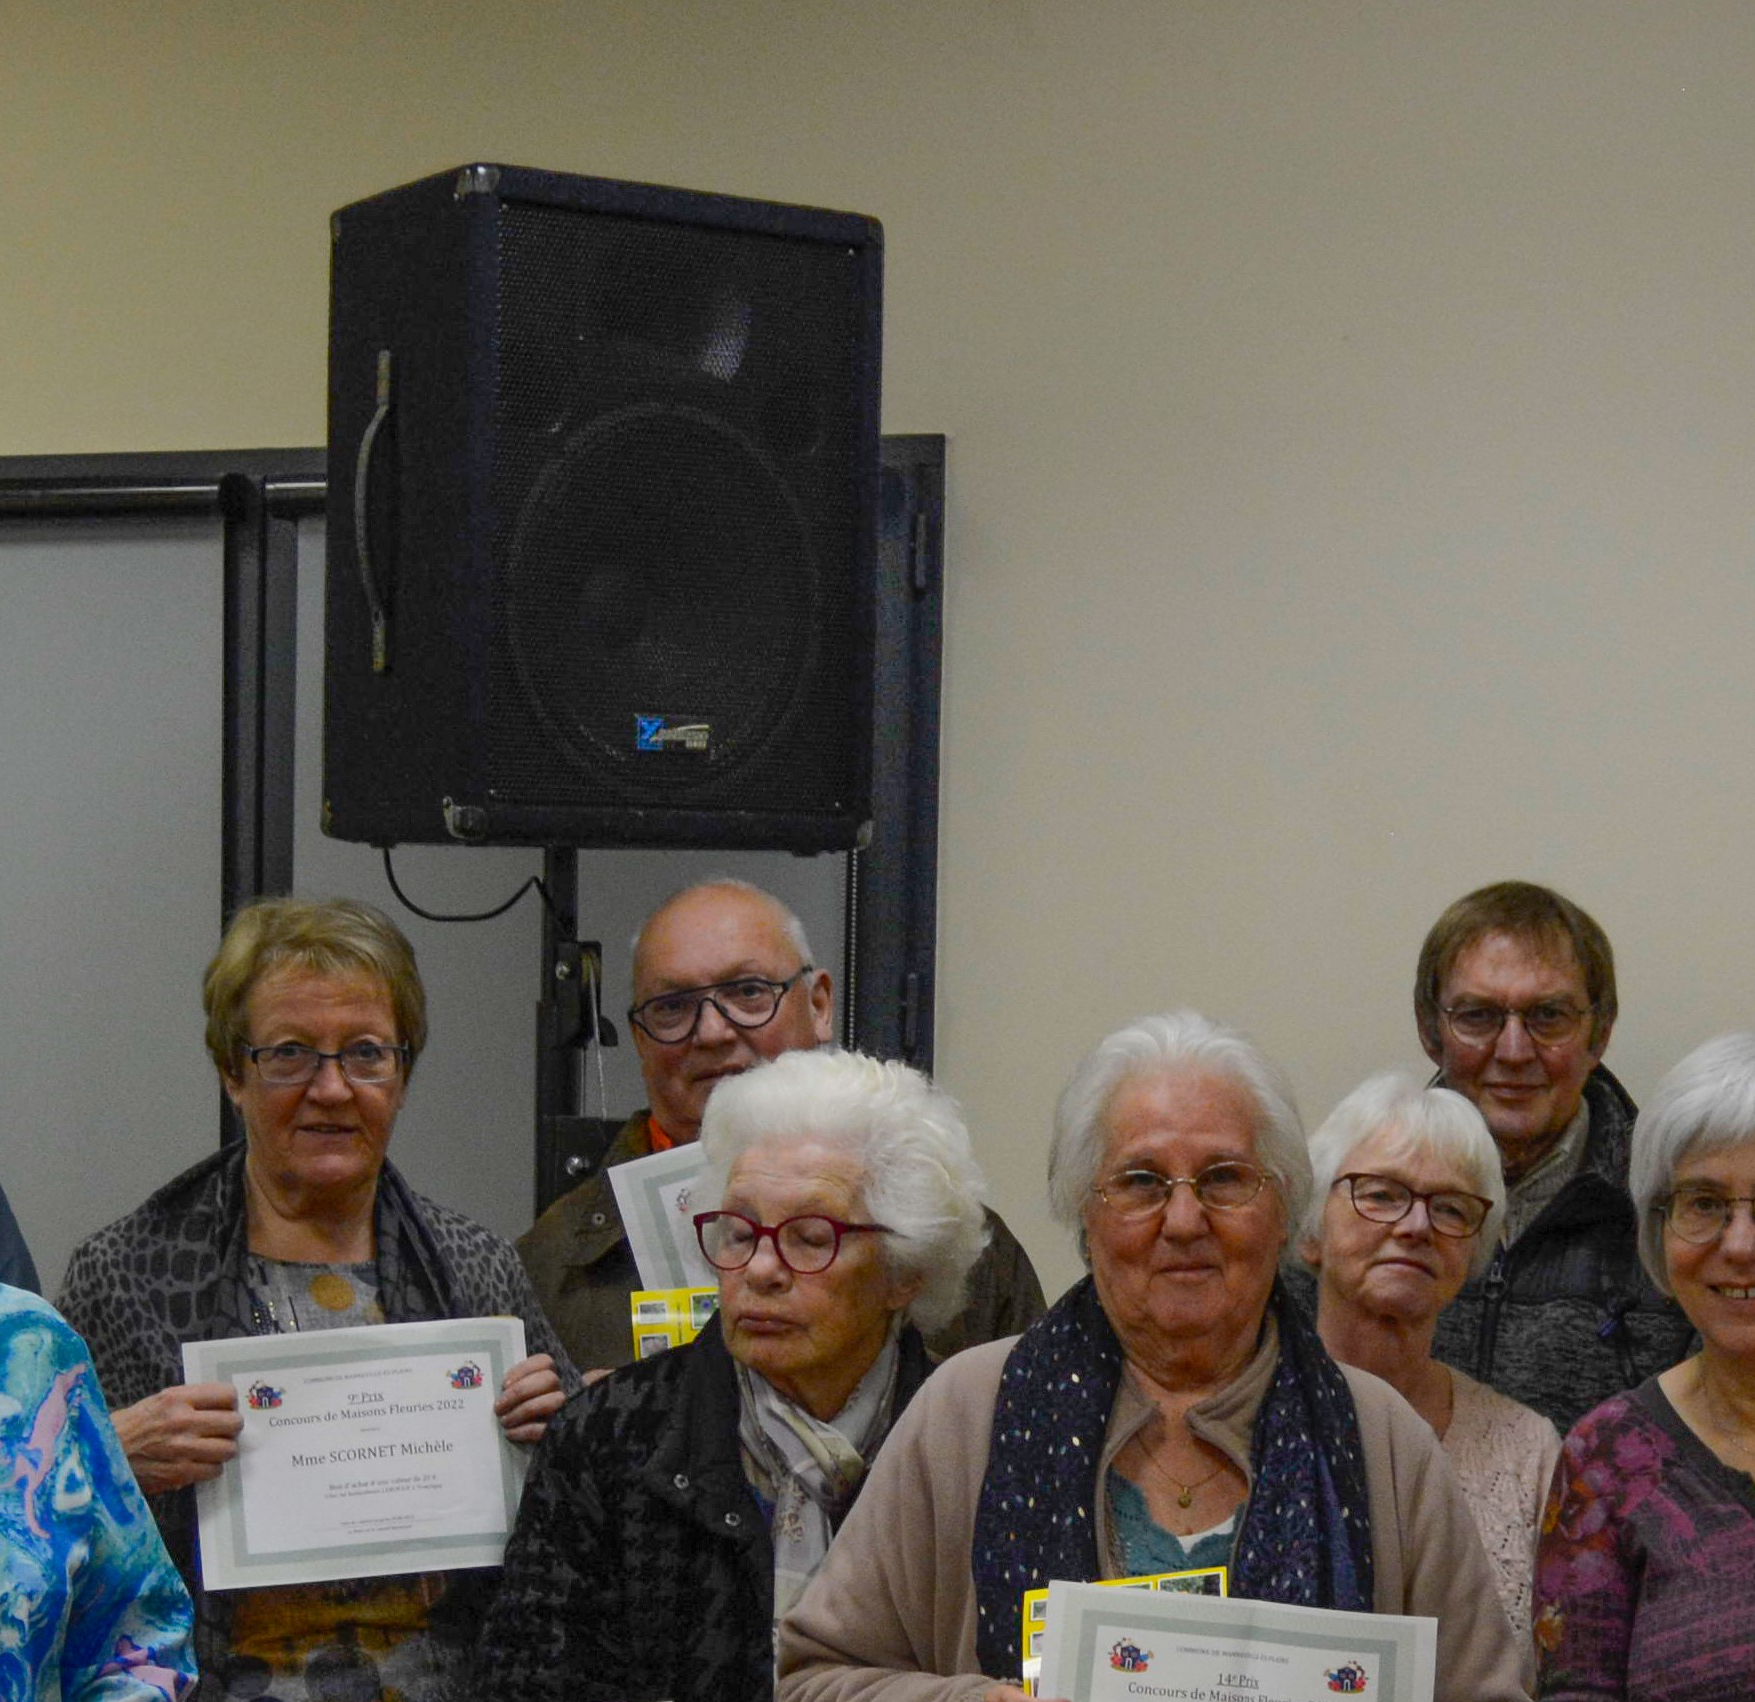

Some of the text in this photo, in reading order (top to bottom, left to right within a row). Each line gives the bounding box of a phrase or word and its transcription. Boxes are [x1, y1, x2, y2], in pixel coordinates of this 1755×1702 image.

[361, 1391, 384, 1403] Prix
[269, 1399, 464, 1427] Concours de Maisons Fleuries 2022
[292, 1439, 453, 1467] Mme SCORNET Michèle
[1128, 1682, 1187, 1699] Concours
[1190, 1688, 1205, 1700] de
[1239, 1674, 1259, 1690] Prix
